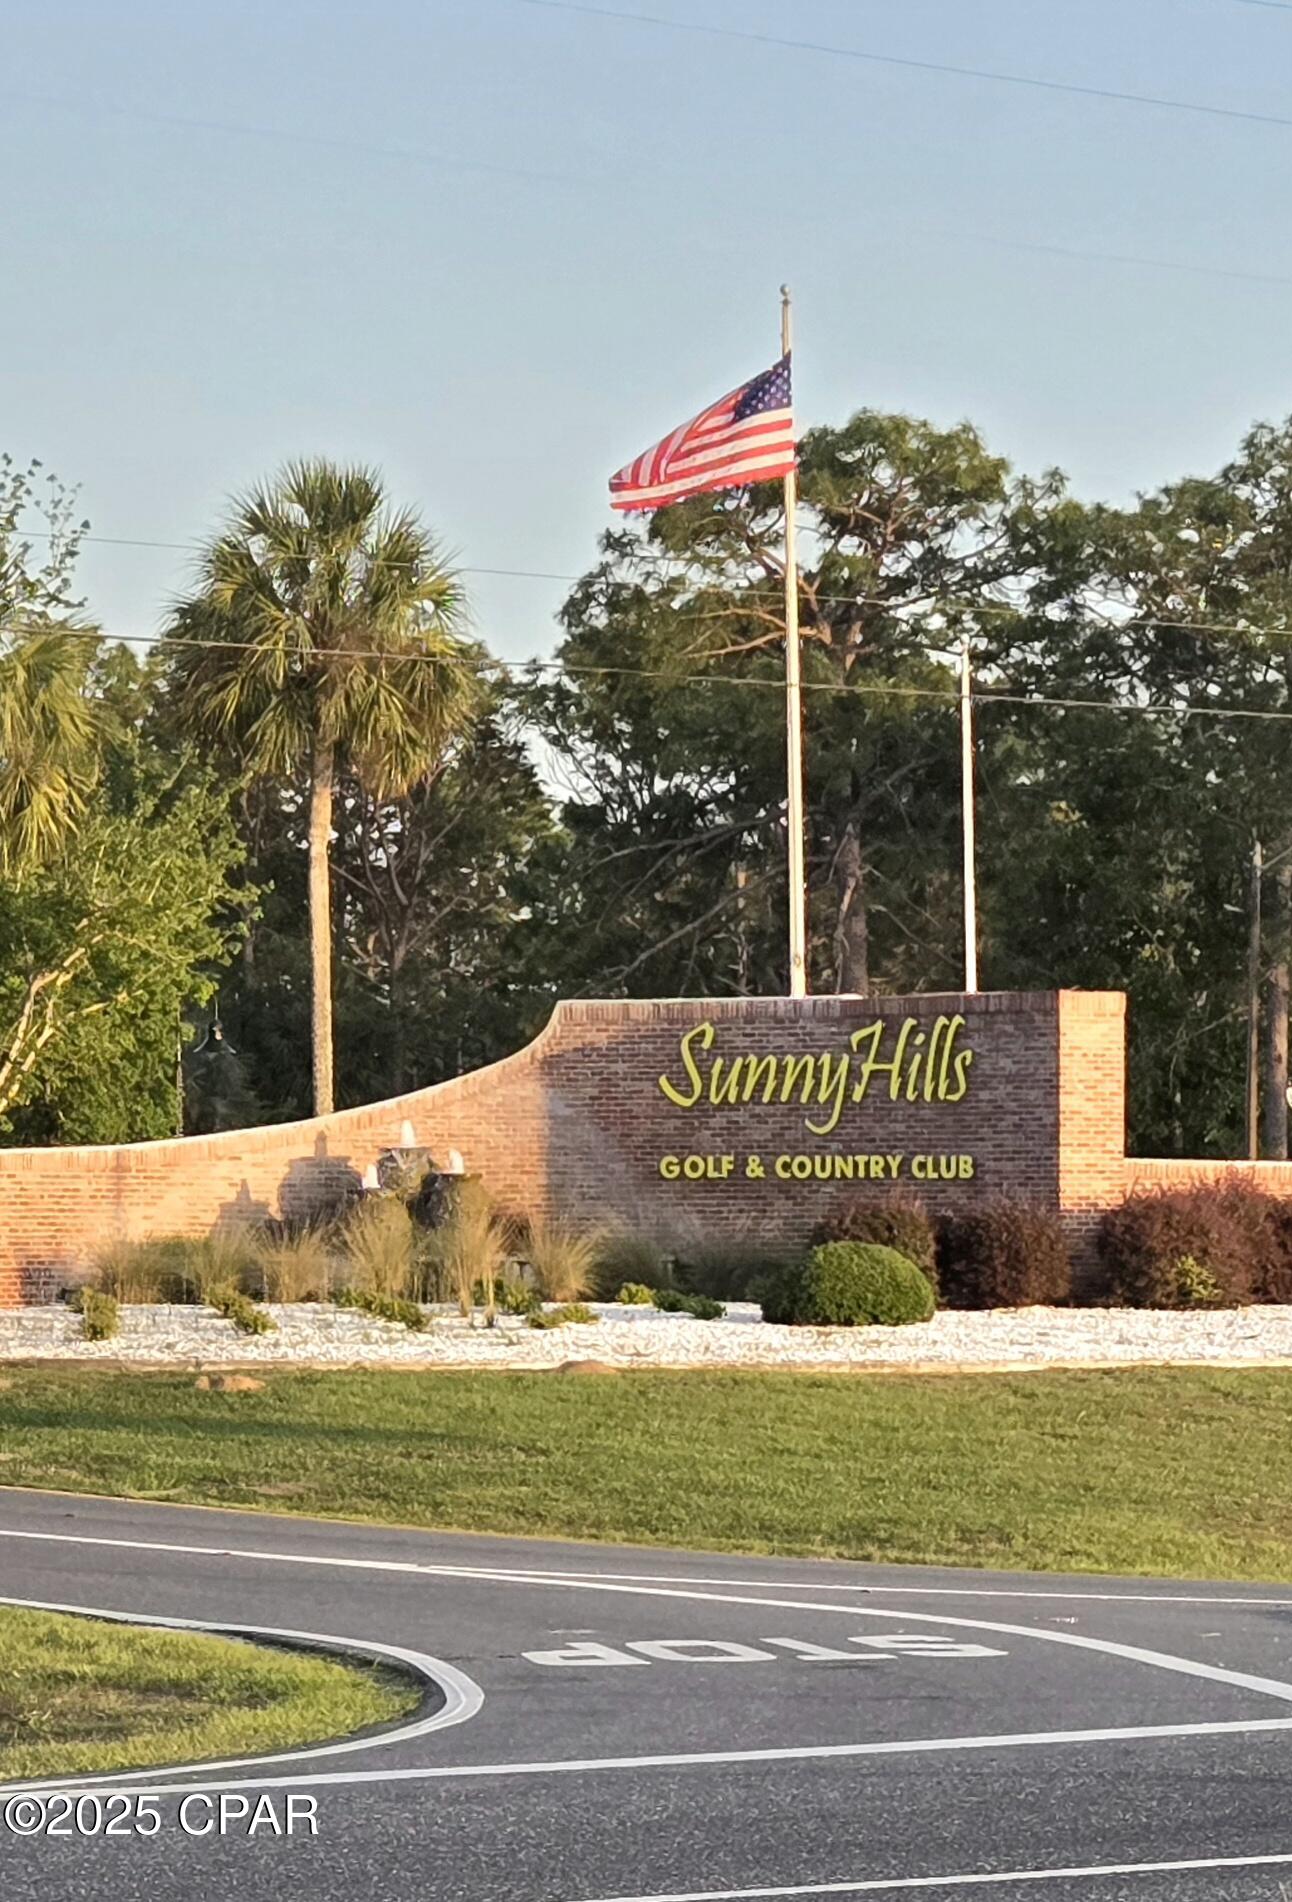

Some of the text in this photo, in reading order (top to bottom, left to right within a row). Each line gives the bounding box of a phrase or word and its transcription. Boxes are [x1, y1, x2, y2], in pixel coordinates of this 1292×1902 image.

[658, 1014, 973, 1134] Sunny Hills
[659, 1154, 975, 1179] GOLF & COUNTRY CLUB
[520, 1634, 1009, 1667] STOP
